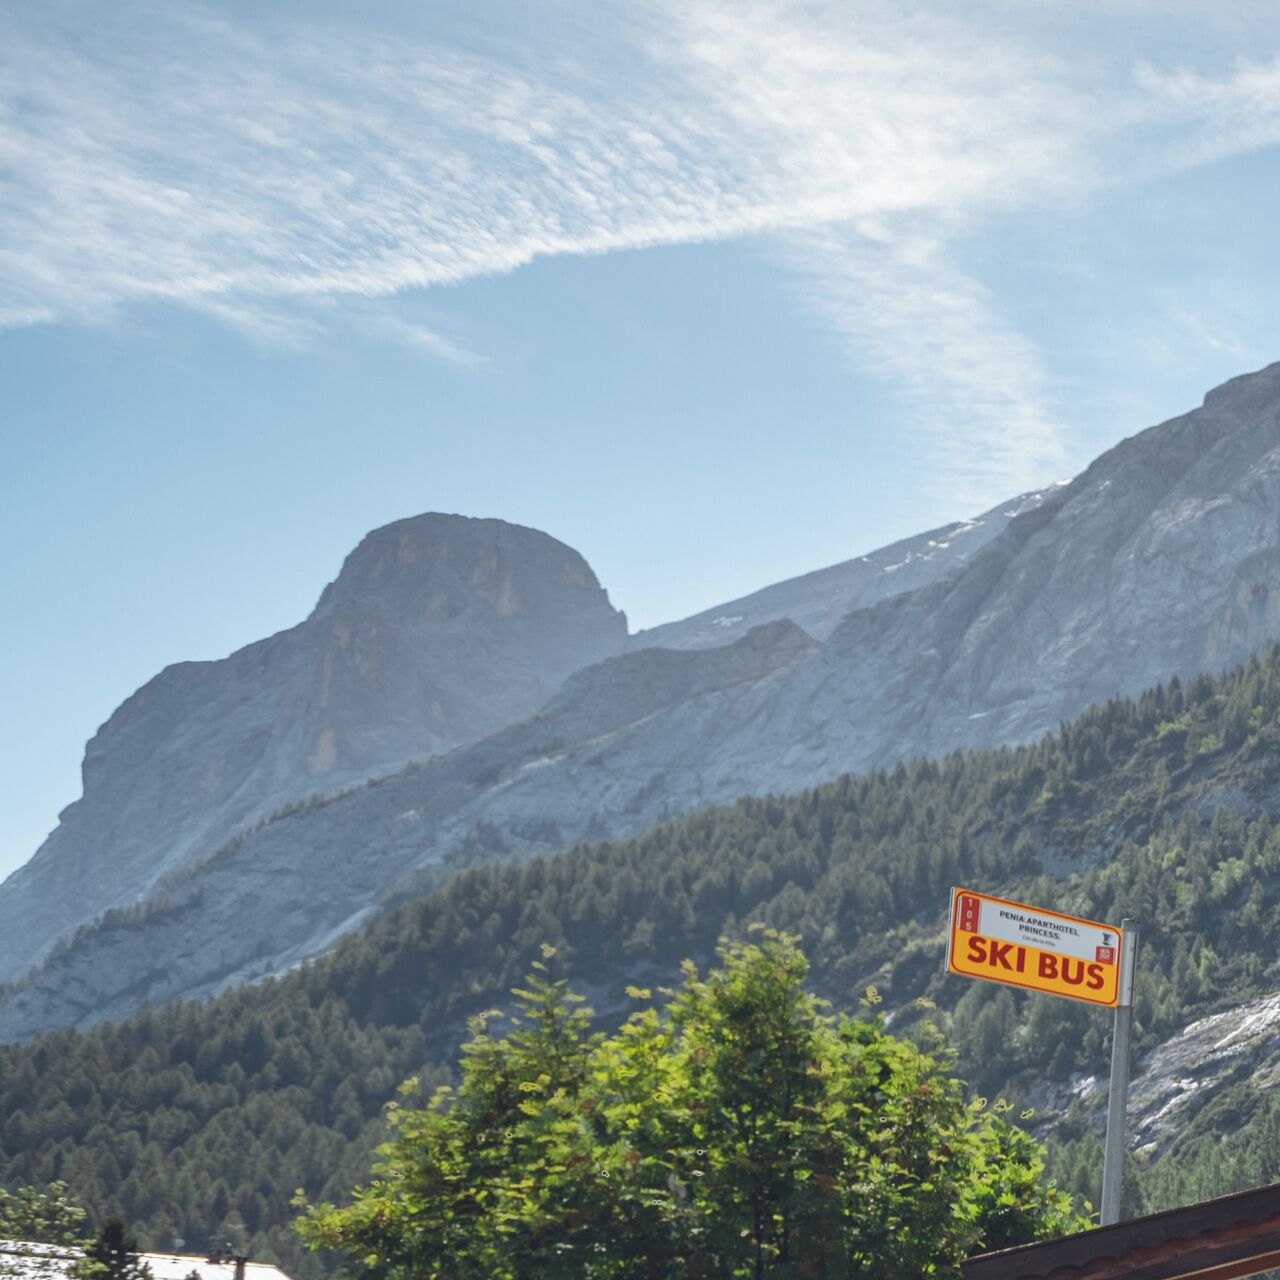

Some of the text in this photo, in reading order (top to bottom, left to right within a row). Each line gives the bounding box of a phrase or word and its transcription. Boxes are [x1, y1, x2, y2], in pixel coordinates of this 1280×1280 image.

[1018, 924, 1060, 940] PRINCESS
[967, 936, 1105, 990] SKI BUS
